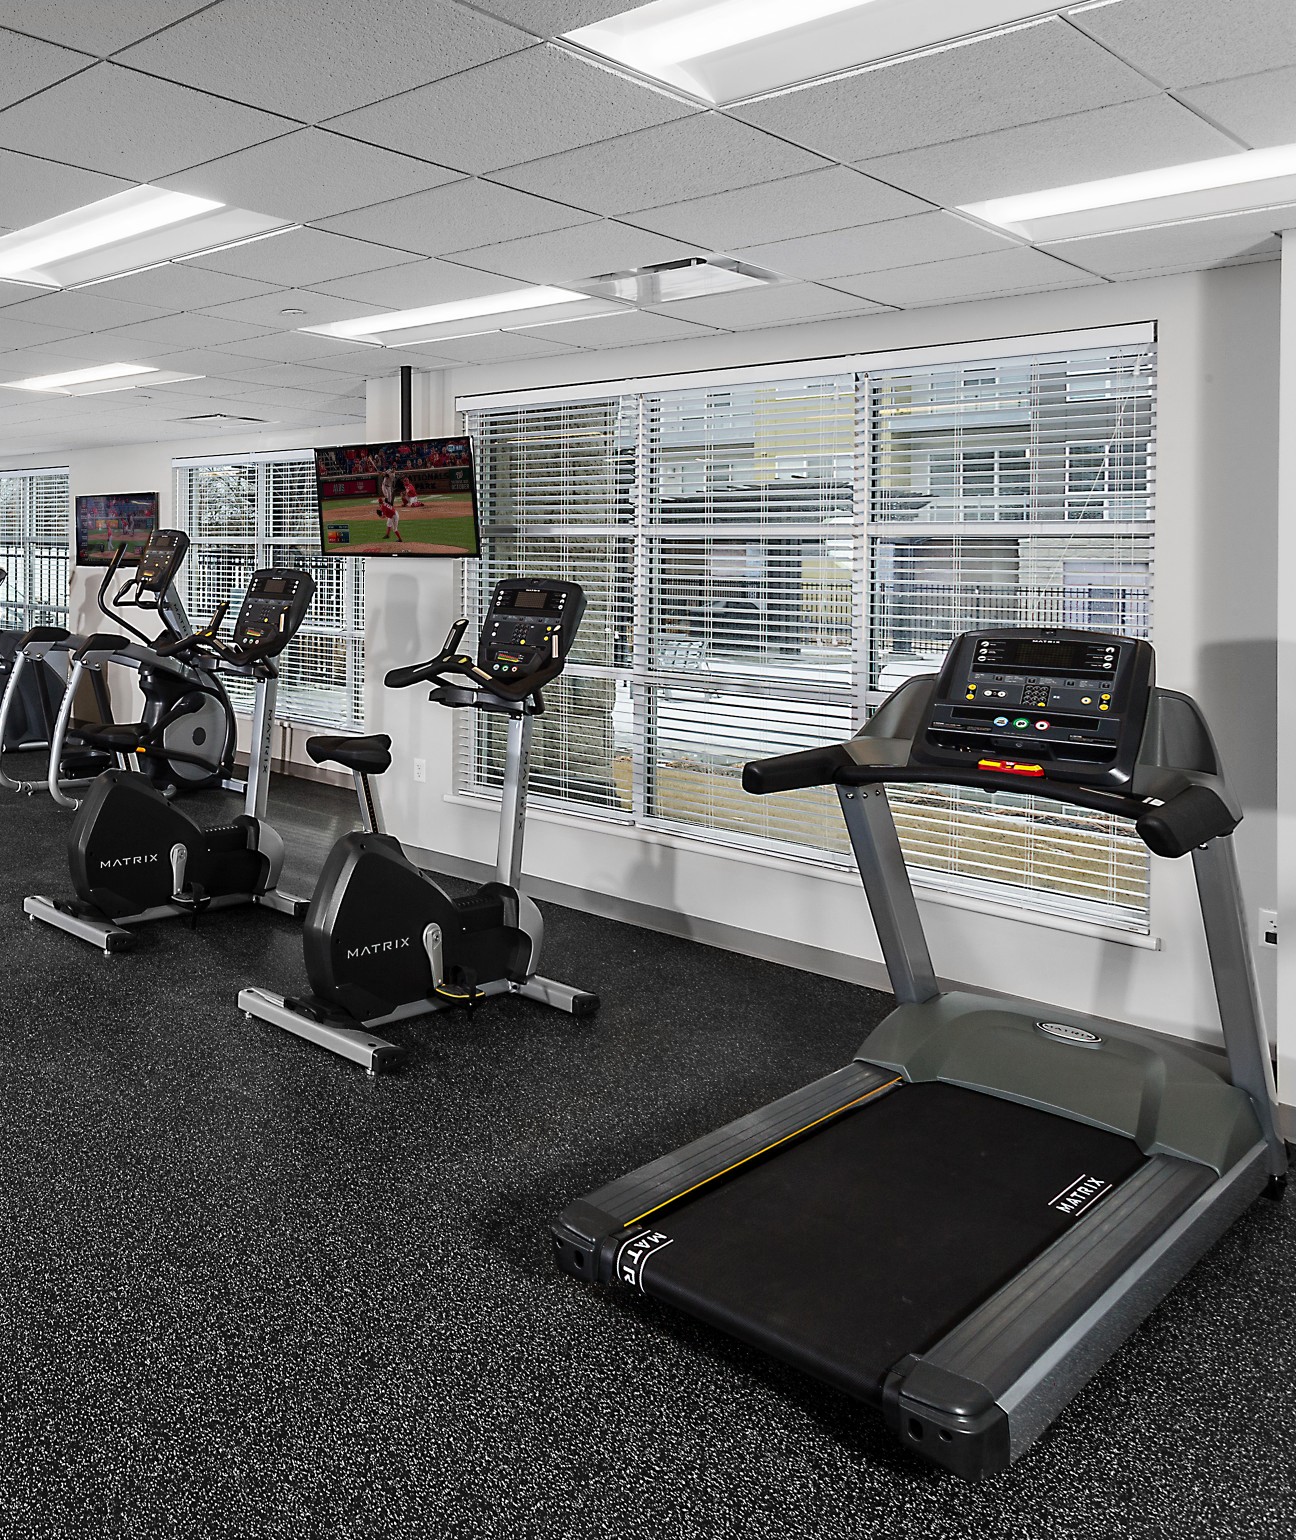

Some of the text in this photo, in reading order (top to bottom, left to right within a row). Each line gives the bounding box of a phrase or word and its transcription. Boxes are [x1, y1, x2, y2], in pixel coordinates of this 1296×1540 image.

[100, 853, 158, 869] MATRIX
[347, 937, 410, 960] MATRIX
[1055, 1176, 1104, 1214] MATRIX
